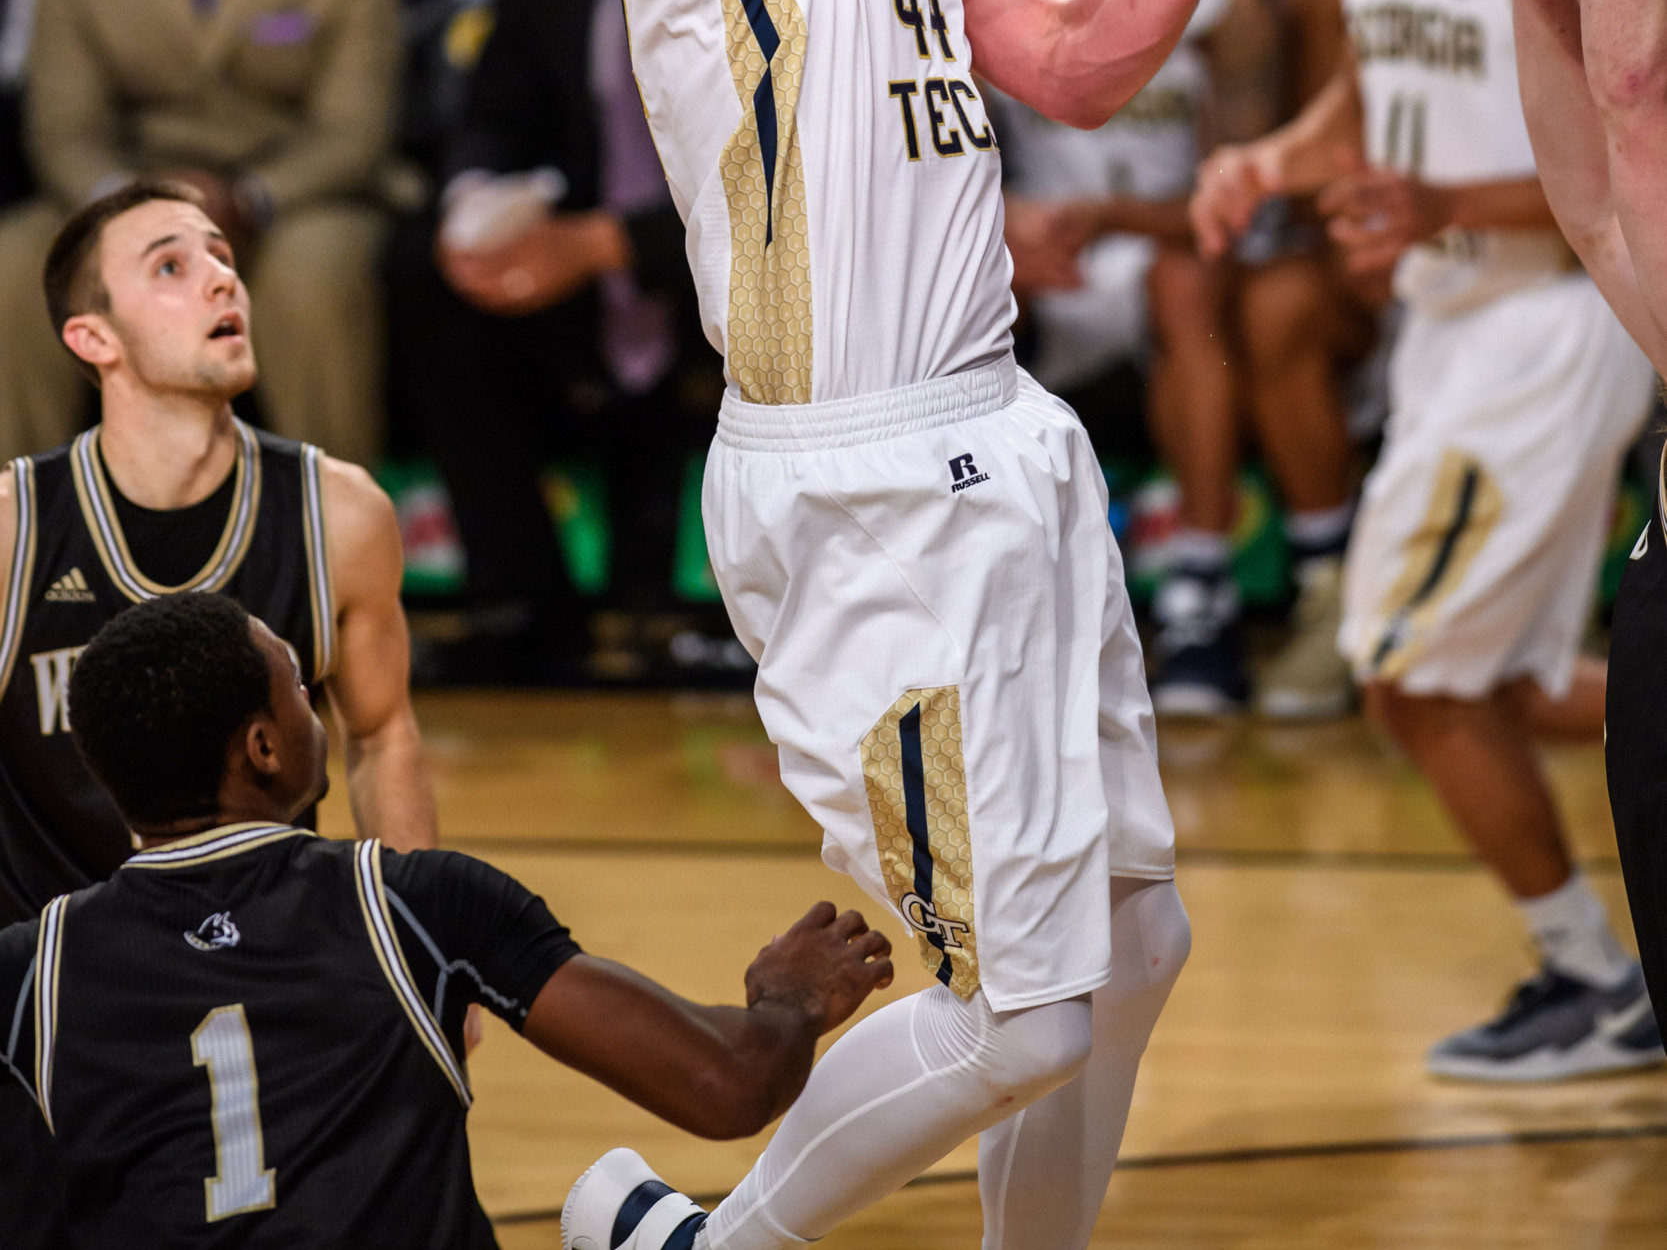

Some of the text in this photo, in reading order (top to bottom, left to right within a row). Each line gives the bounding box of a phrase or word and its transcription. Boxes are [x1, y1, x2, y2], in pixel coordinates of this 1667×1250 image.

[888, 76, 1000, 162] TEC
[951, 472, 990, 494] RUSSELL
[190, 1003, 277, 1223] 1
